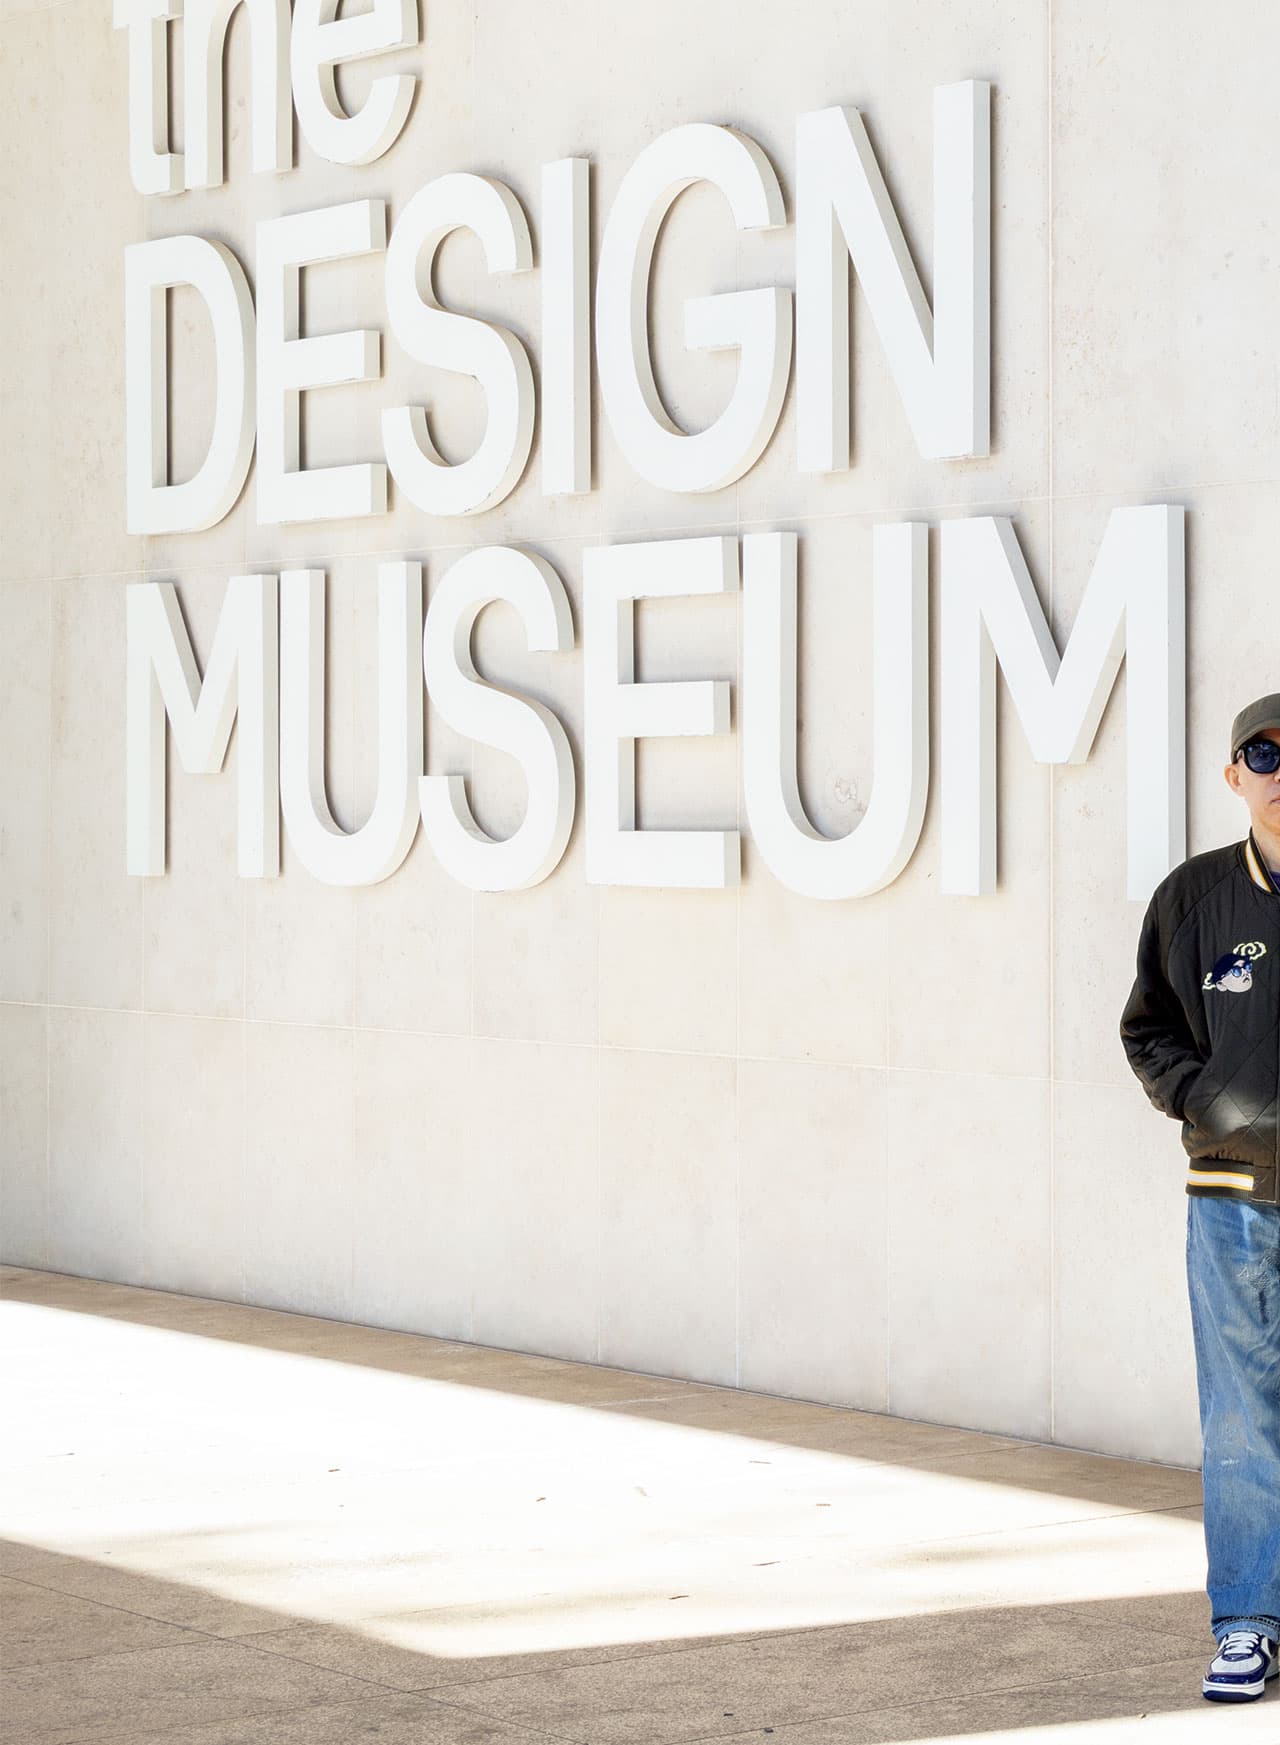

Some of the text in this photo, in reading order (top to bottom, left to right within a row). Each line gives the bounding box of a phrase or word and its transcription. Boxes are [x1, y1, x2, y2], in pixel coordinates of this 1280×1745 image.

[113, 0, 418, 196] the
[125, 79, 991, 536] DESIGN
[126, 504, 1186, 902] MUSEUM
